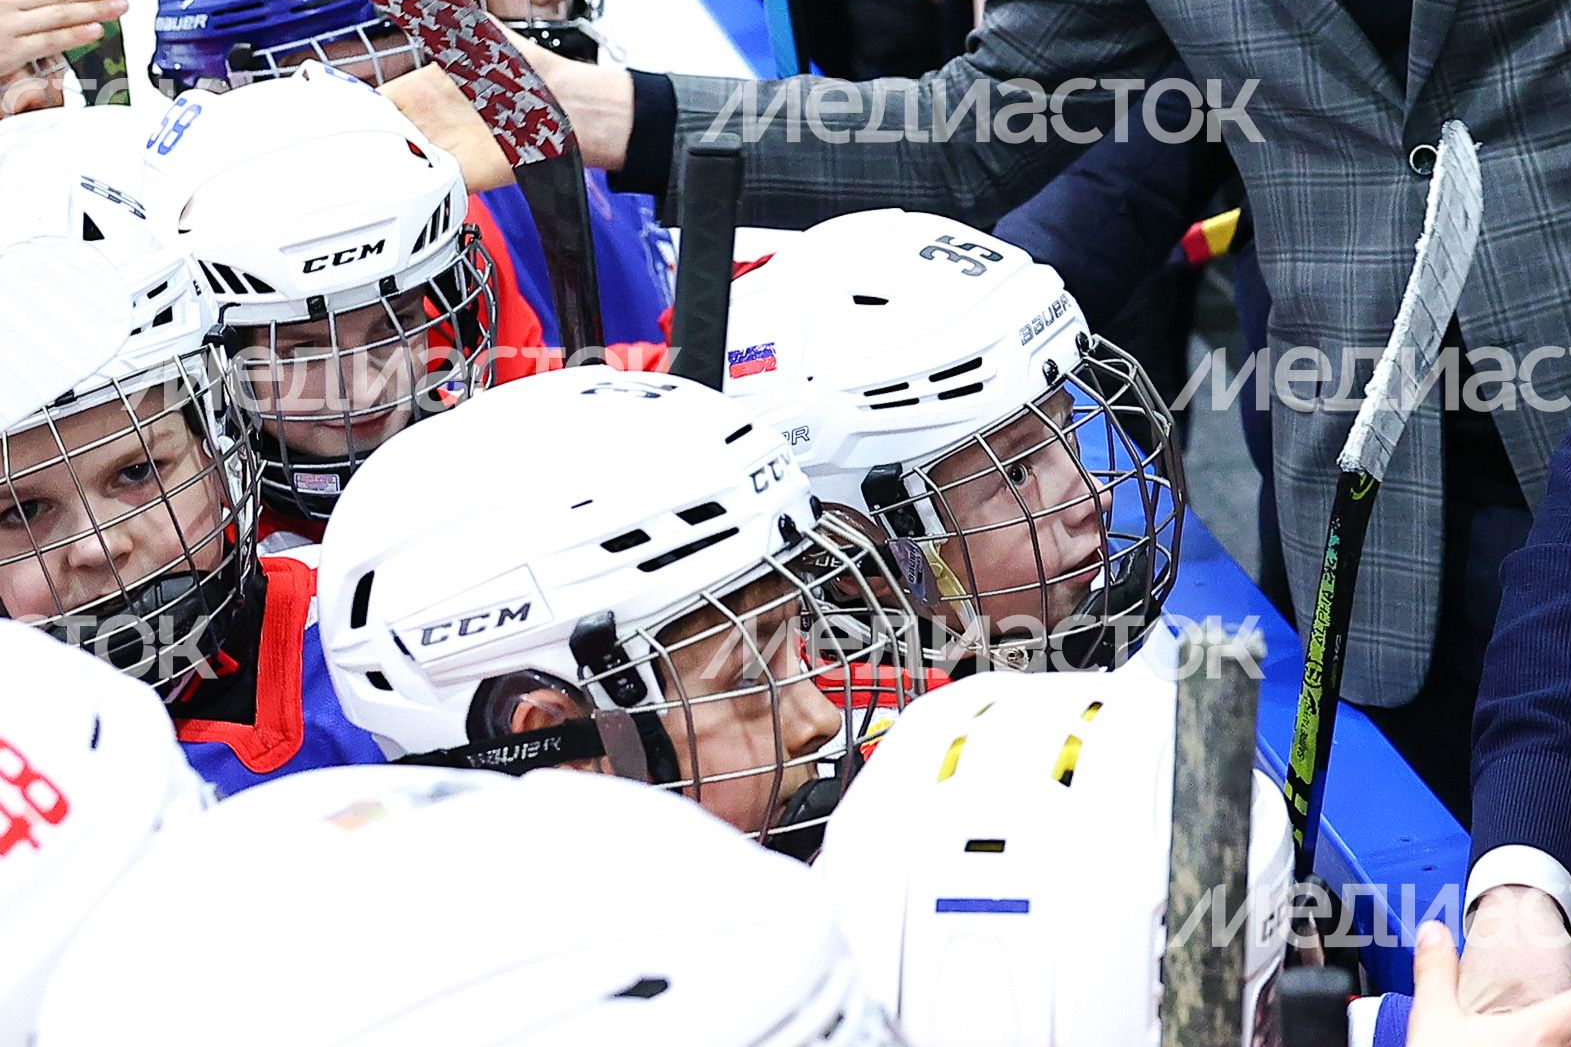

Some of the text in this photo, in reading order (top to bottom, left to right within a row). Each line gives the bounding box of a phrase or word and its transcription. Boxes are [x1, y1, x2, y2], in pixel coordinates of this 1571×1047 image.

[303, 239, 387, 274] CCM
[919, 235, 1004, 277] 35
[1020, 290, 1074, 346] BAUER
[420, 601, 532, 646] CCM
